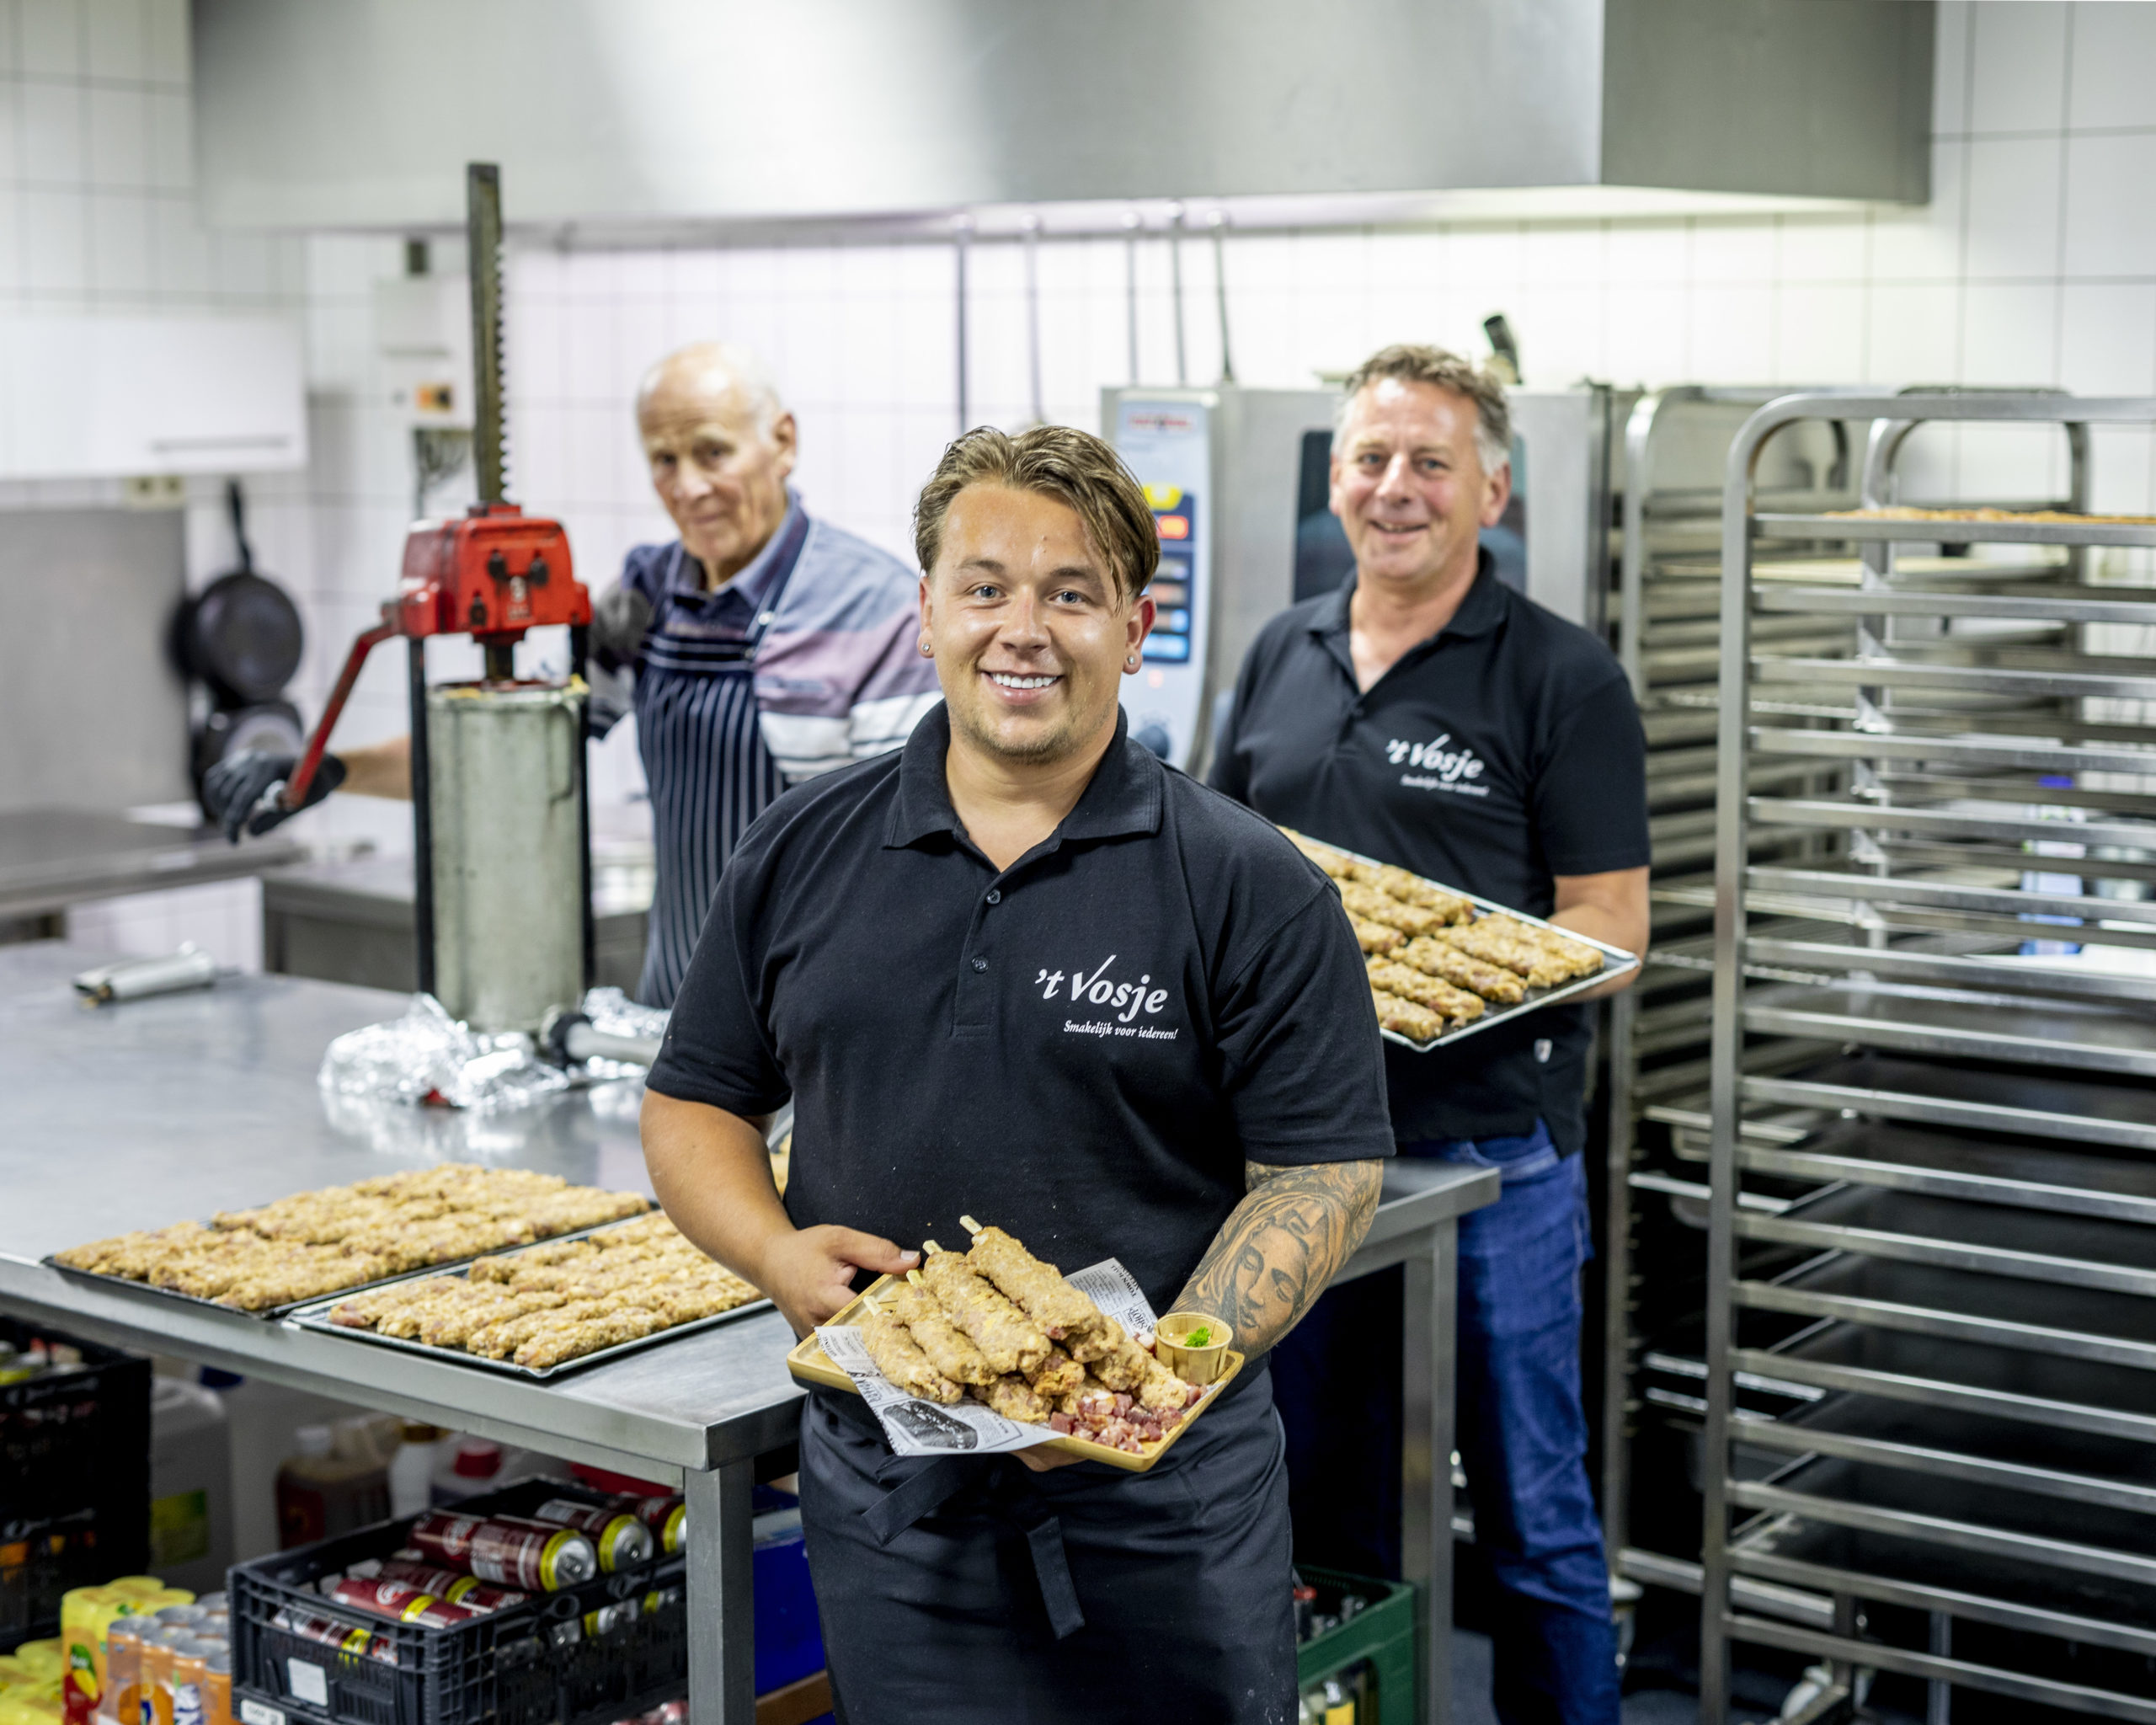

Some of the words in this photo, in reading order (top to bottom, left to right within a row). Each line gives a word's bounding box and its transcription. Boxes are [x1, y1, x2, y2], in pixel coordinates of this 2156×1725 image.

[1385, 739, 1410, 765] 't
[1409, 733, 1485, 782] Vosje
[1034, 969, 1065, 1000] 't
[1070, 954, 1169, 1023] Vosje
[1064, 1019, 1113, 1038] Smakelijk
[1114, 1028, 1137, 1037] voor
[1138, 1026, 1178, 1039] iedereen!
